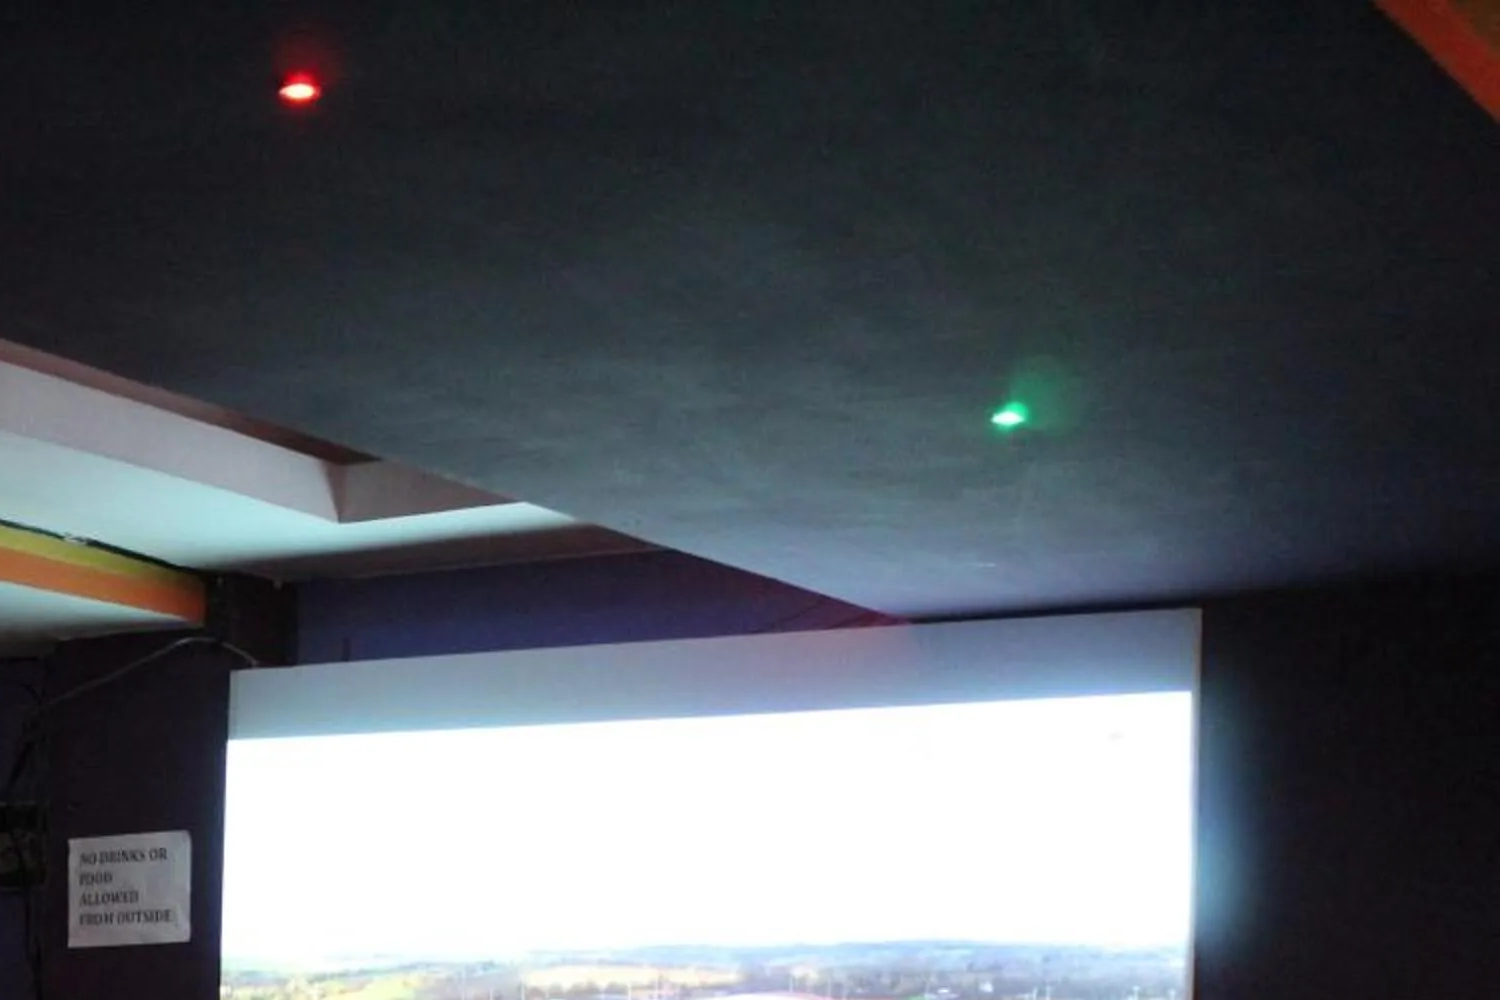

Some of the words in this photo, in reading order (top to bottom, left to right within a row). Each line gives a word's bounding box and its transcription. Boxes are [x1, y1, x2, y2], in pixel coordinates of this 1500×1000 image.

[99, 849, 145, 864] DRINKS
[149, 847, 168, 861] OR
[79, 871, 113, 886] FOOD
[79, 890, 139, 906] ALLOWED
[79, 912, 114, 926] FROM
[117, 909, 172, 925] OUTSIDE
